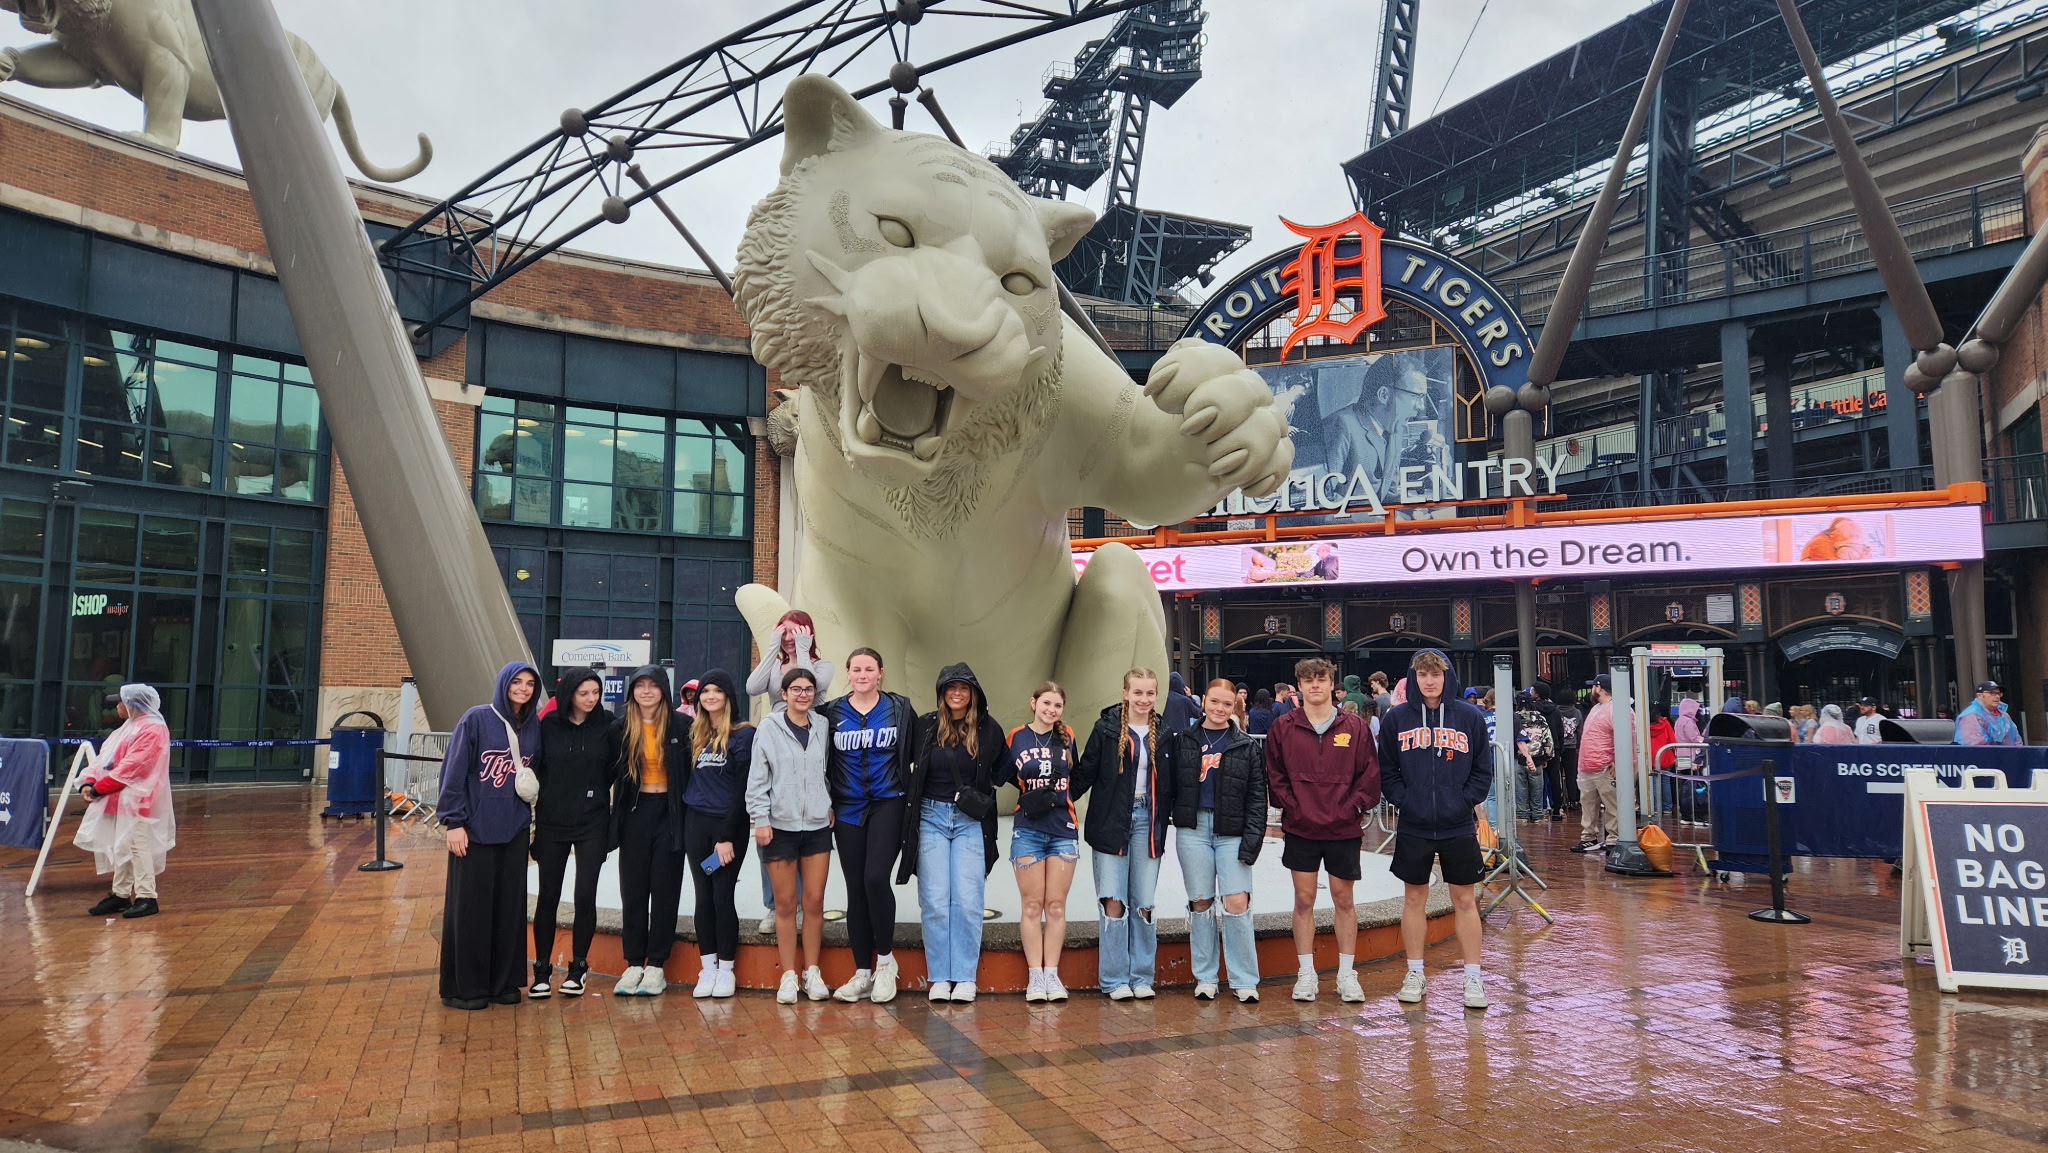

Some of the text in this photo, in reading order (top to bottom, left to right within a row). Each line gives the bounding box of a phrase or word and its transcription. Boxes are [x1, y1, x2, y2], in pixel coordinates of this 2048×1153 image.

[1197, 254, 1523, 367] ROIT TIGERS
[1400, 453, 1567, 504] ENTRY
[1402, 539, 1692, 572] Own the Dream.
[76, 594, 108, 616] SHOP
[608, 652, 632, 662] Bank
[604, 680, 623, 694] ATE
[833, 729, 874, 751] MOTOR
[1398, 727, 1469, 753] TIGERS
[1837, 763, 1872, 776] BAG
[1964, 823, 2025, 853] NO
[1956, 858, 2046, 890] BAG
[1956, 895, 2048, 928] LINE
